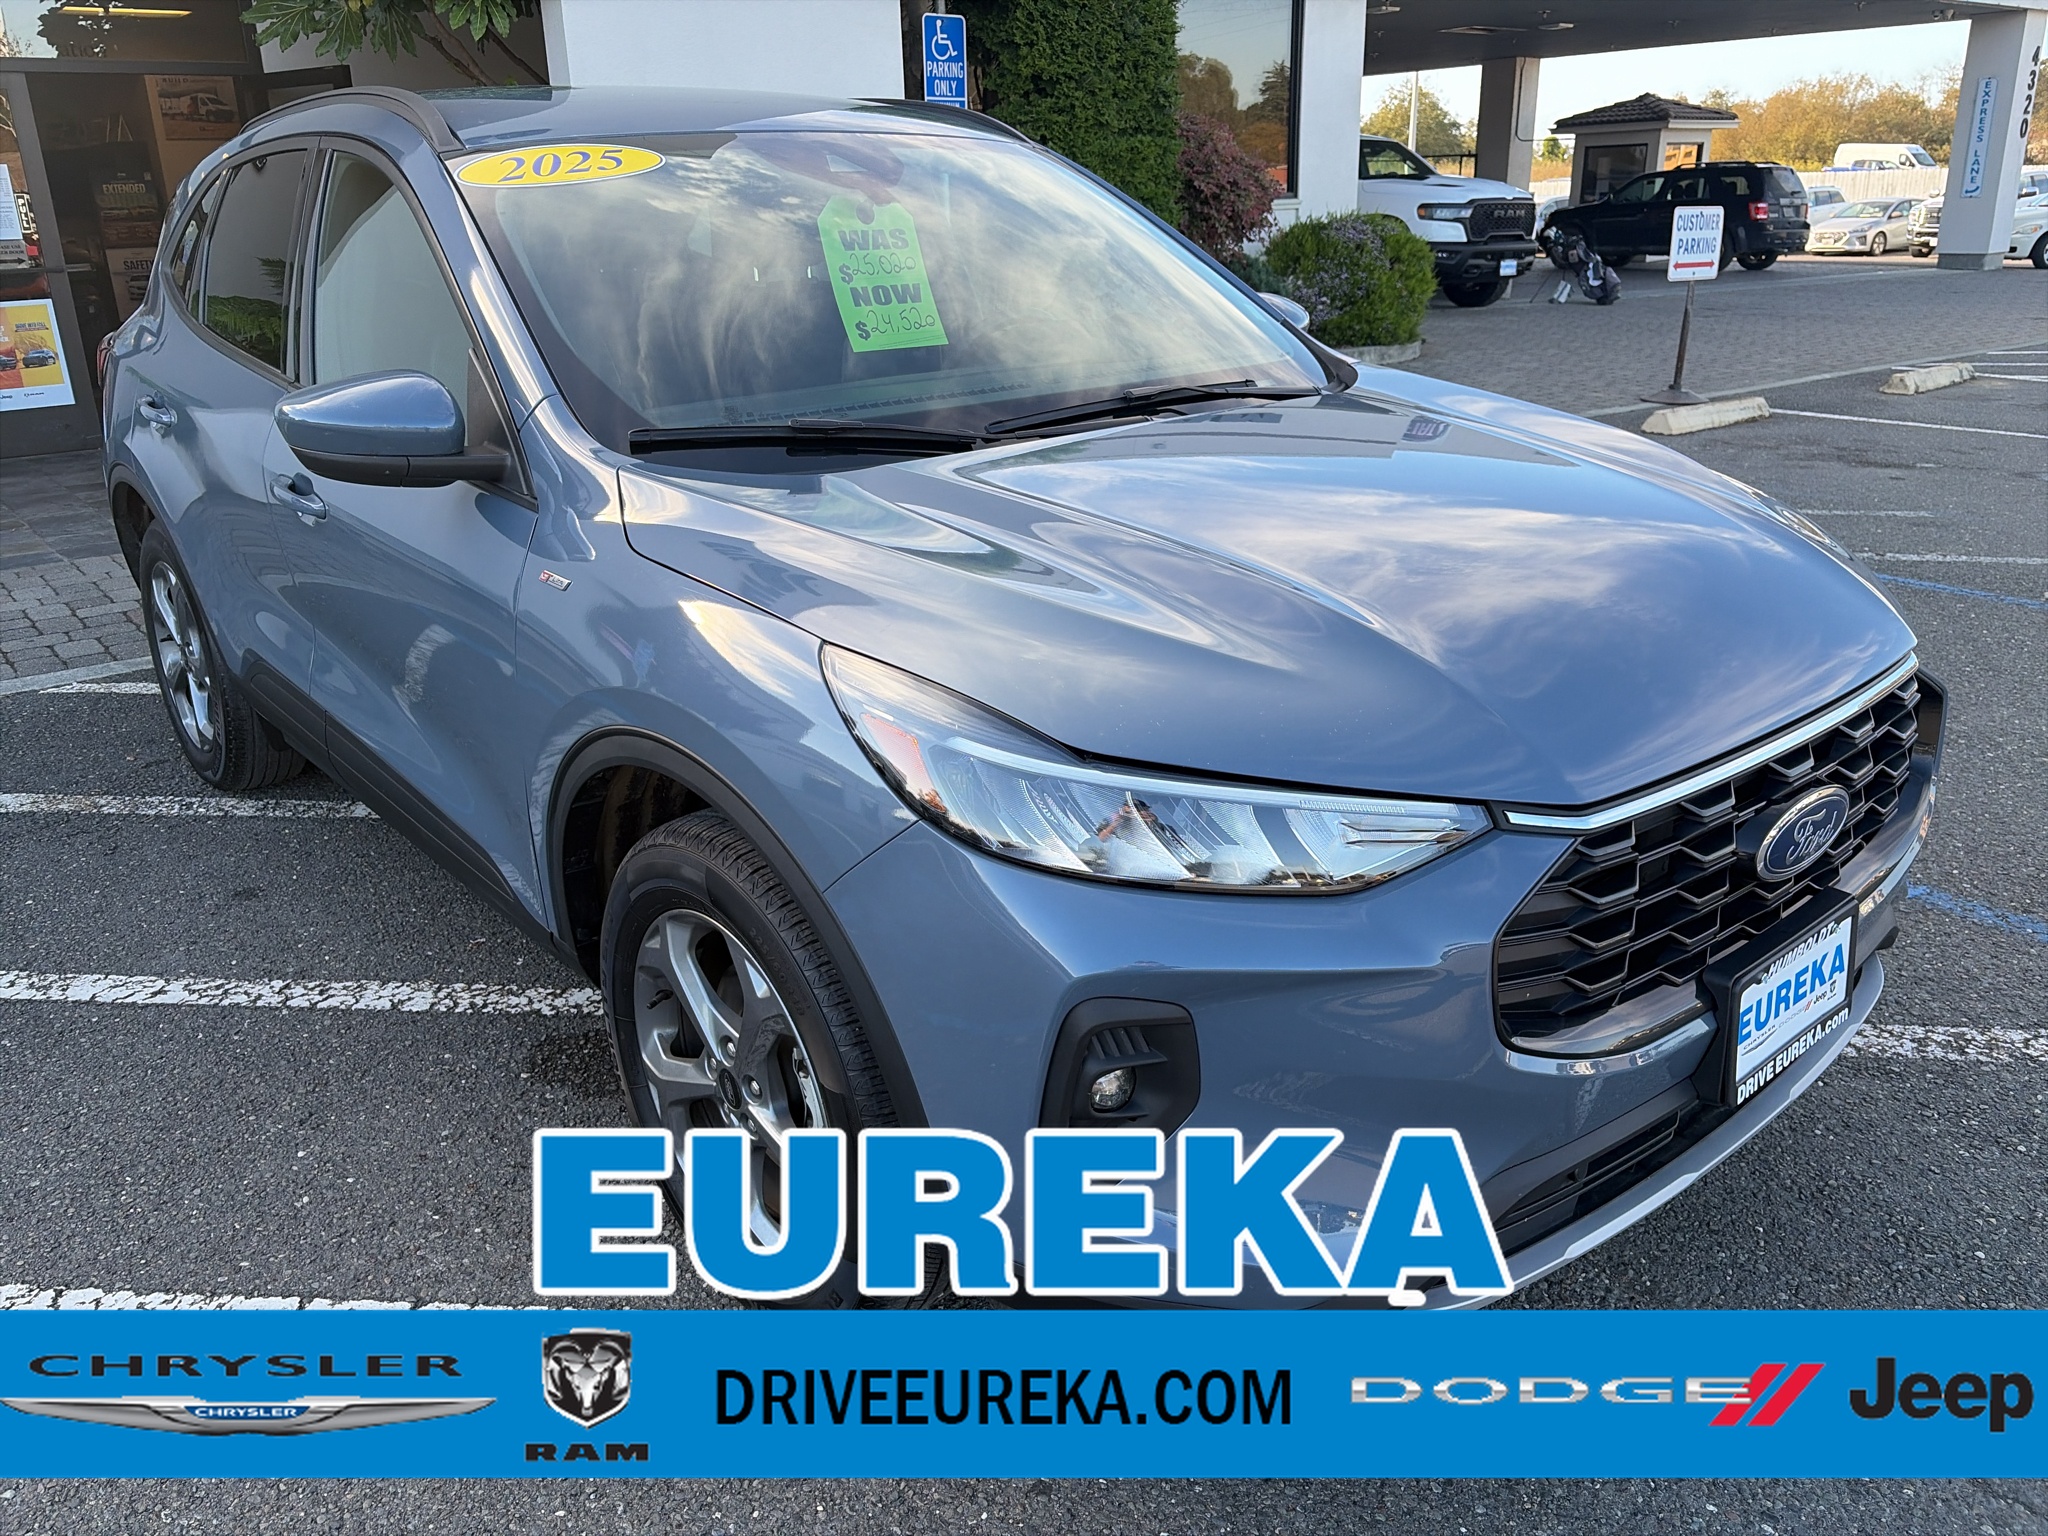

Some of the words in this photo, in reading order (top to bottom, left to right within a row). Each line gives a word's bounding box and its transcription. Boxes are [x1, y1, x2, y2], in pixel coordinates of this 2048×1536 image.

[927, 61, 963, 78] PARKING
[934, 79, 957, 96] ONLY
[2020, 45, 2041, 139] 4320
[1976, 80, 1992, 143] EXPRESS
[497, 149, 623, 183] 2025
[1969, 149, 1981, 184] LANE
[102, 183, 146, 194] EXTENDED
[17, 198, 30, 228] PULL
[1493, 209, 1526, 218] RAM
[1677, 213, 1720, 231] CUSTOMER
[839, 228, 909, 251] WAS
[1677, 237, 1717, 255] PARKING
[850, 283, 923, 308] NOW
[1786, 808, 1839, 866] Ford
[1767, 921, 1836, 979] HUMBOLDT
[1738, 943, 1845, 1046] EUREKA
[1743, 1024, 1776, 1050] CHRYSLER
